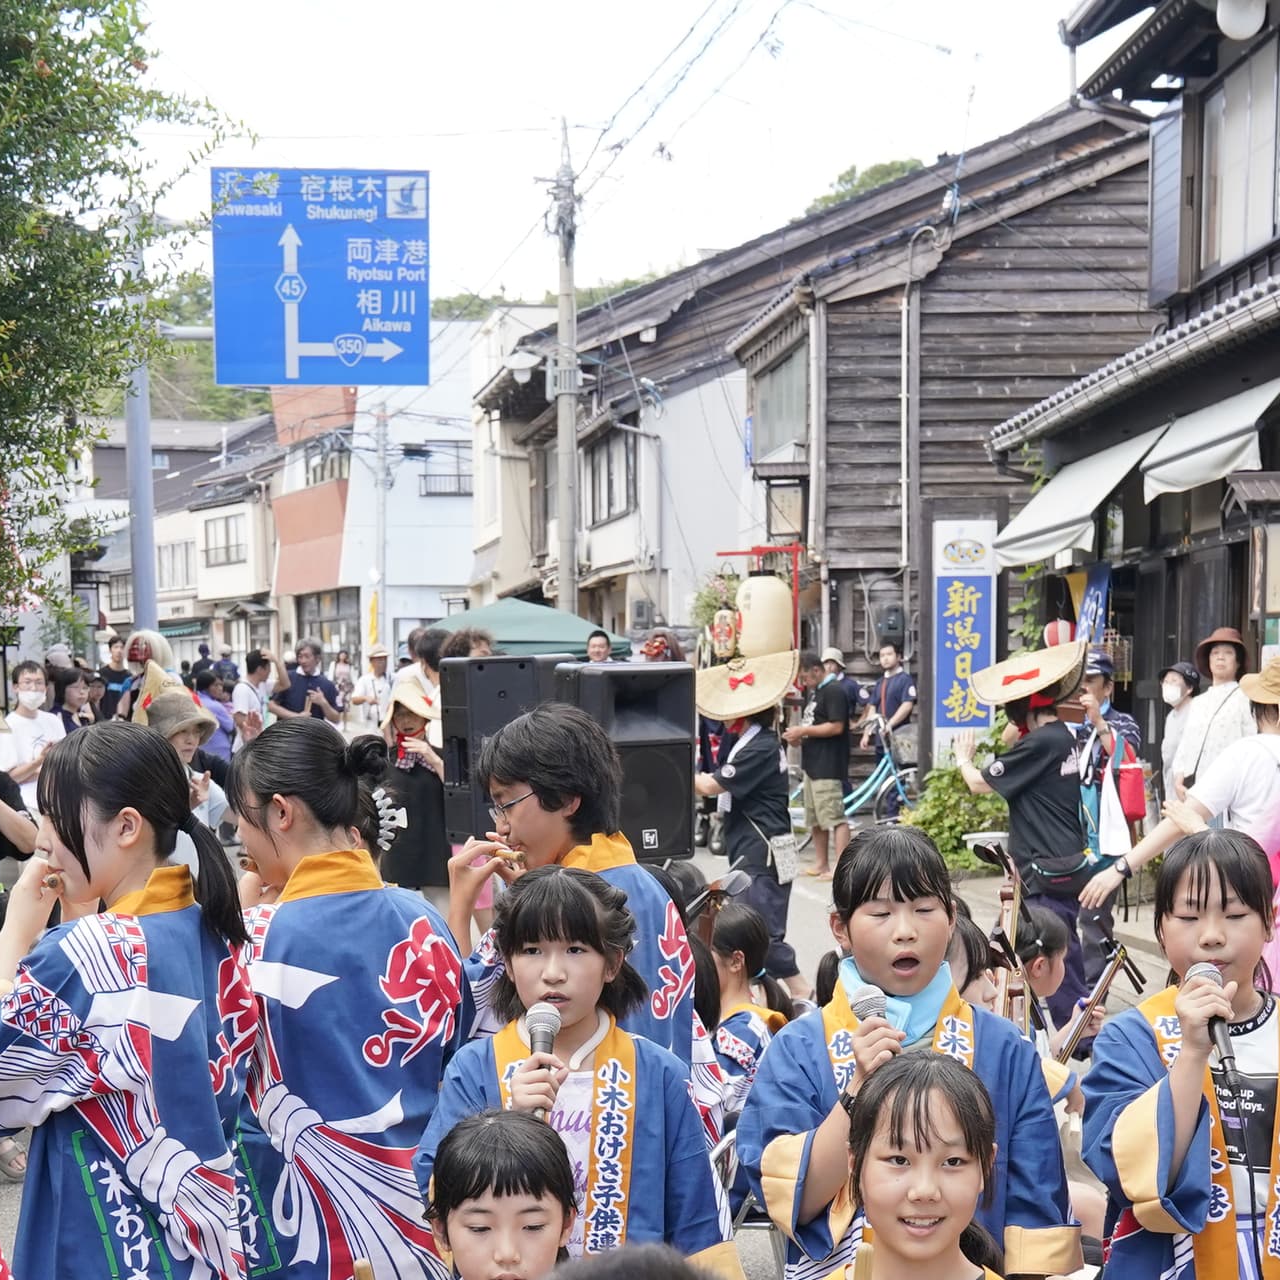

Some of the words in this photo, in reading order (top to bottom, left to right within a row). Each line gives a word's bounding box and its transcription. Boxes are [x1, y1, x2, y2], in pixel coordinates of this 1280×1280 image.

[300, 176, 383, 203] 宿根木
[347, 238, 427, 265] 両津港
[281, 279, 300, 296] 45
[347, 267, 393, 282] Ryotsu
[397, 267, 426, 281] Port
[356, 289, 416, 315] 相川
[361, 318, 412, 332] Aikawa
[337, 338, 362, 354] 350
[943, 580, 987, 724] 新潟日報
[587, 1061, 629, 1253] 小木おけさ子供連
